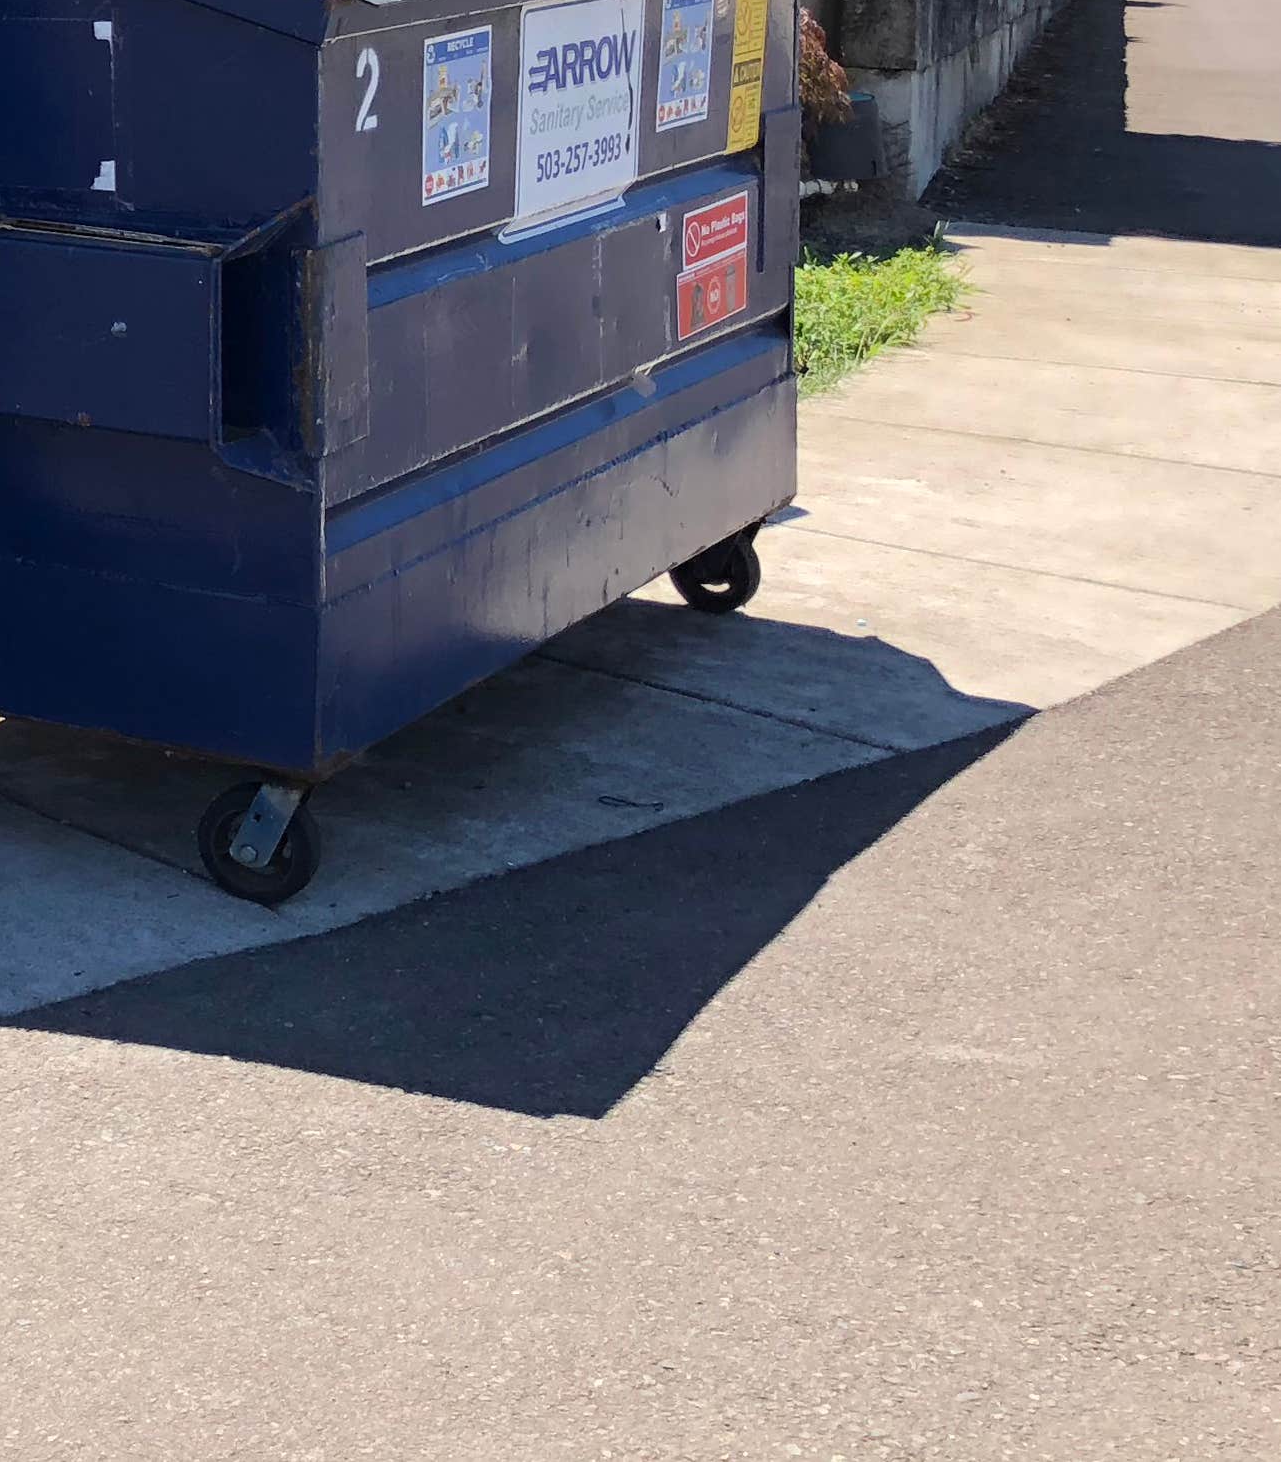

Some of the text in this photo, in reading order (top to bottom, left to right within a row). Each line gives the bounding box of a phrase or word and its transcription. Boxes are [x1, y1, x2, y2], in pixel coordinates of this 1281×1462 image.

[541, 29, 636, 92] ARROW
[356, 47, 379, 132] 2
[529, 90, 629, 135] Sanitary Service
[536, 133, 622, 183] 503-257-3993
